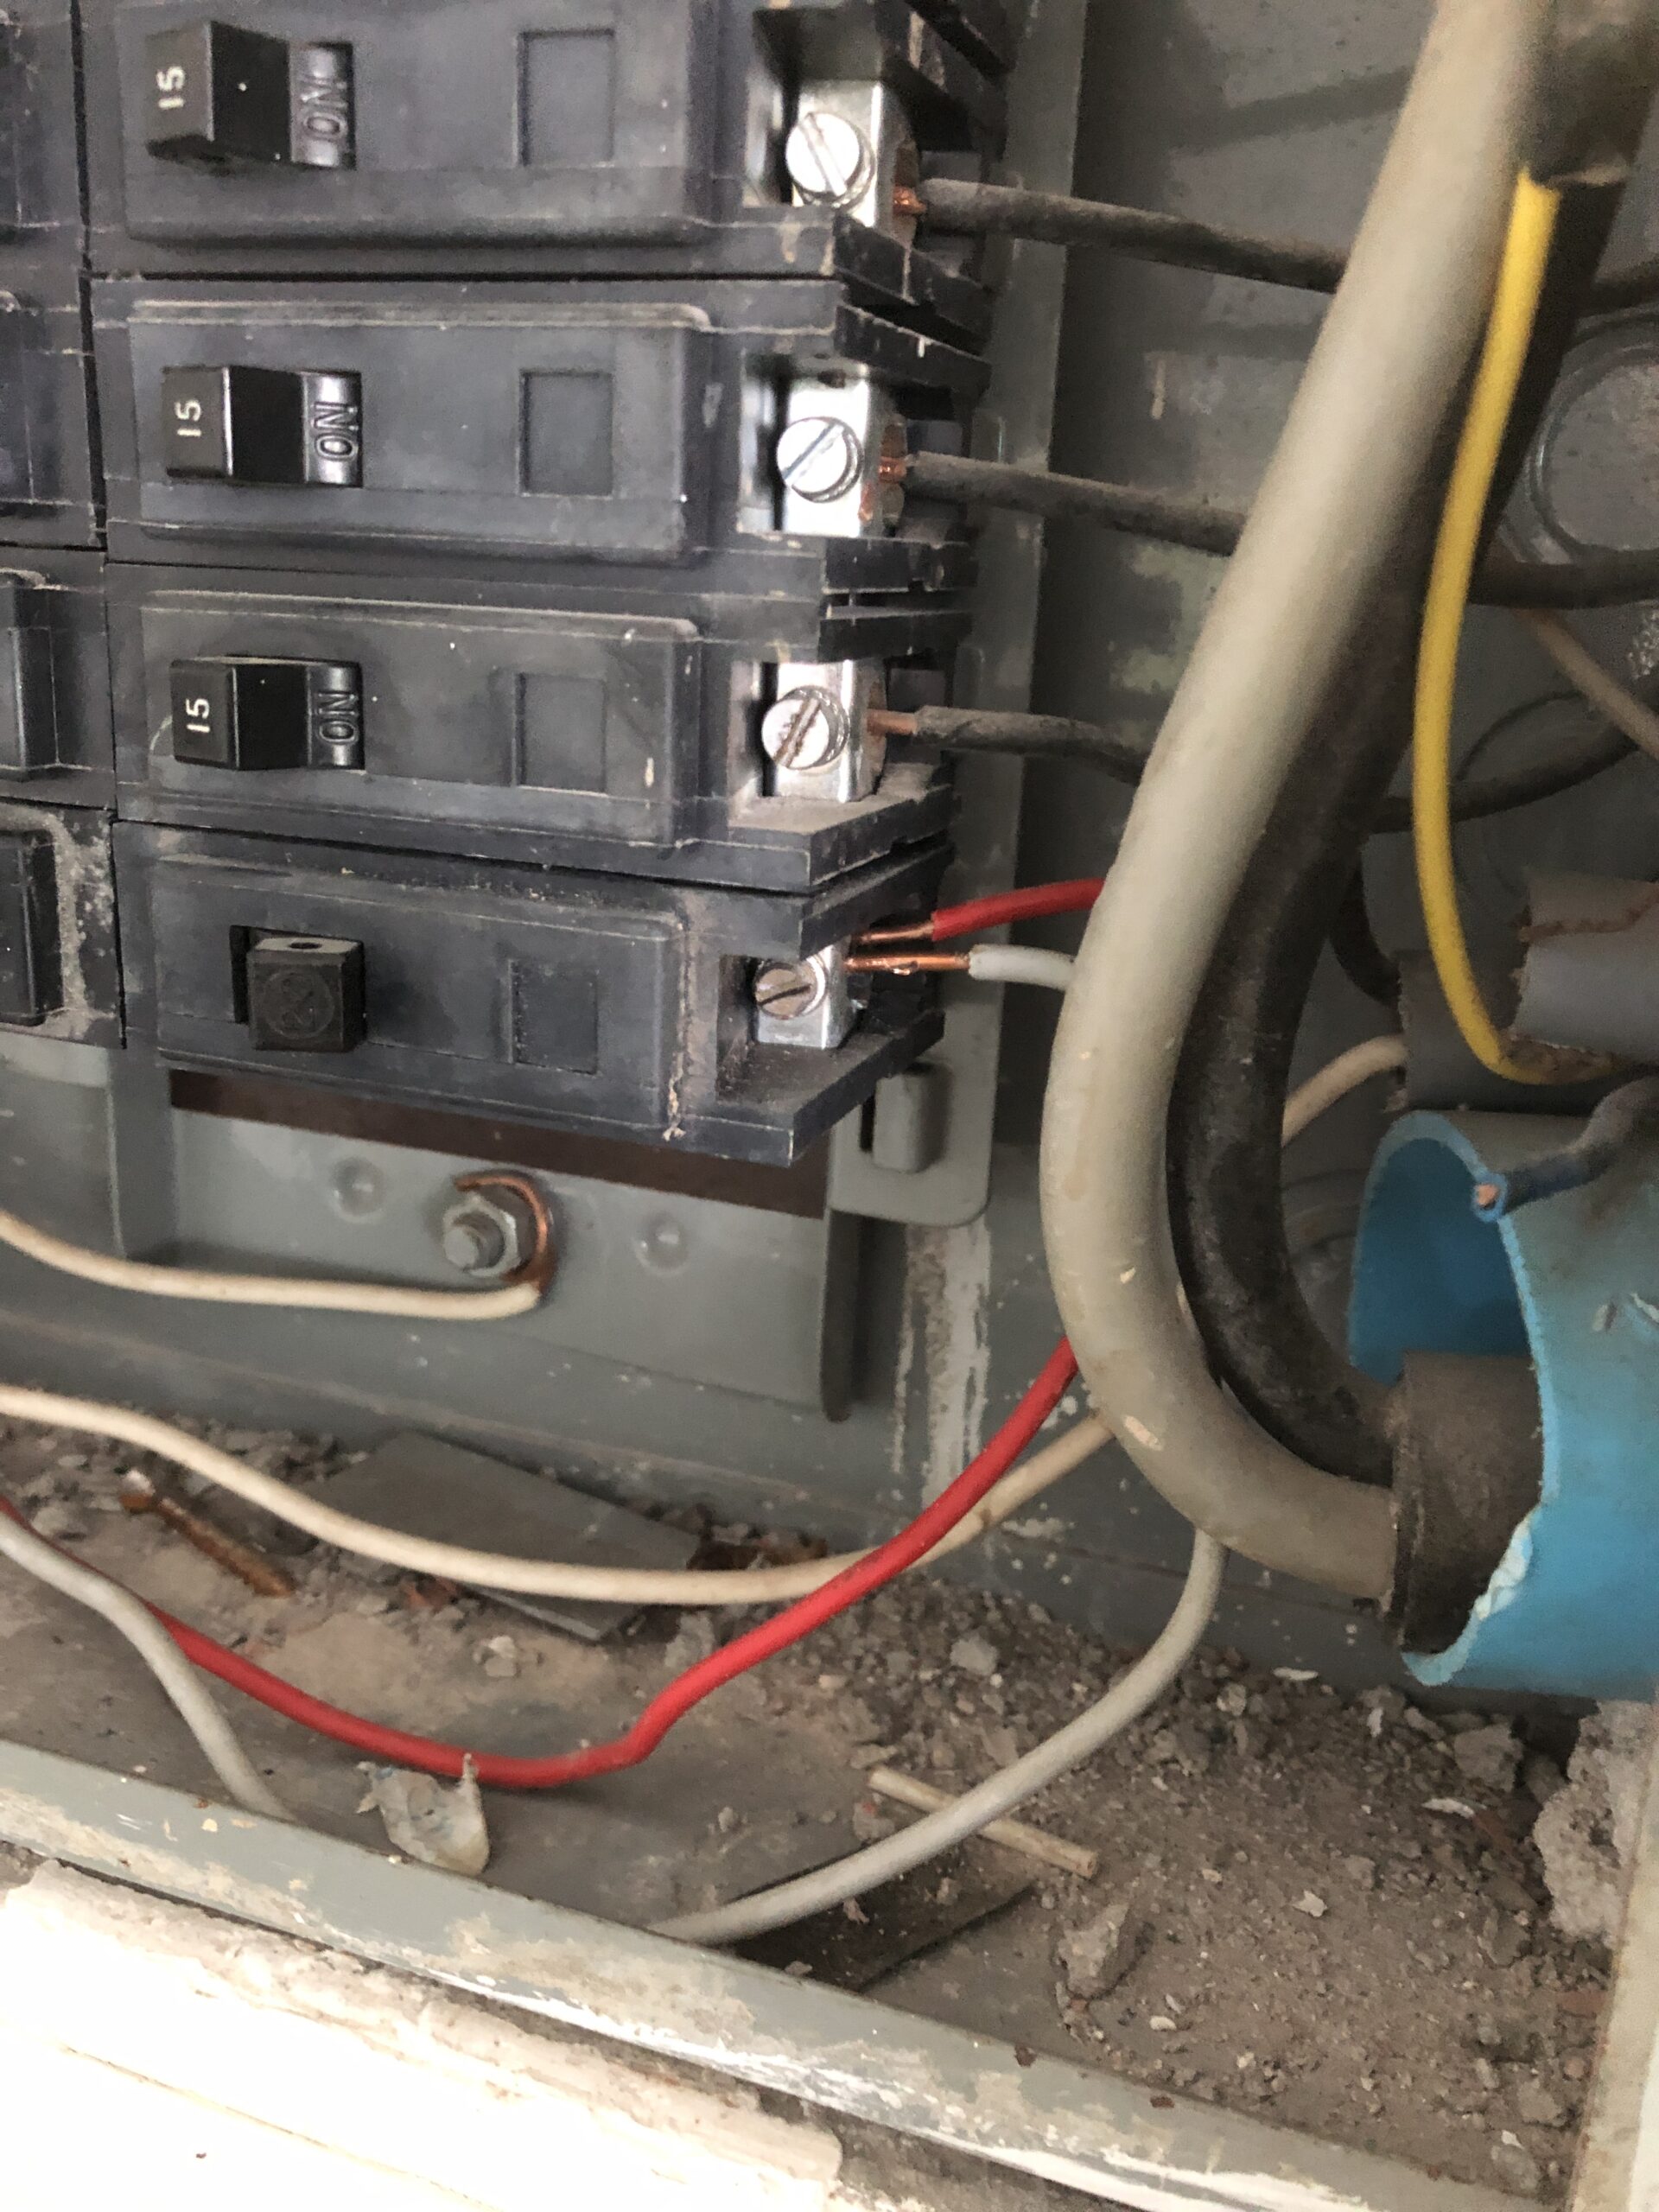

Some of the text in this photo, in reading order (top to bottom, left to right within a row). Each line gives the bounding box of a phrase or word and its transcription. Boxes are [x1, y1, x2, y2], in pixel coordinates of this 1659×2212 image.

[156, 66, 186, 111] 15
[302, 79, 347, 143] ON
[175, 400, 202, 437] 15
[311, 403, 359, 462] ON
[186, 698, 212, 734] 15
[316, 692, 359, 744] ON
